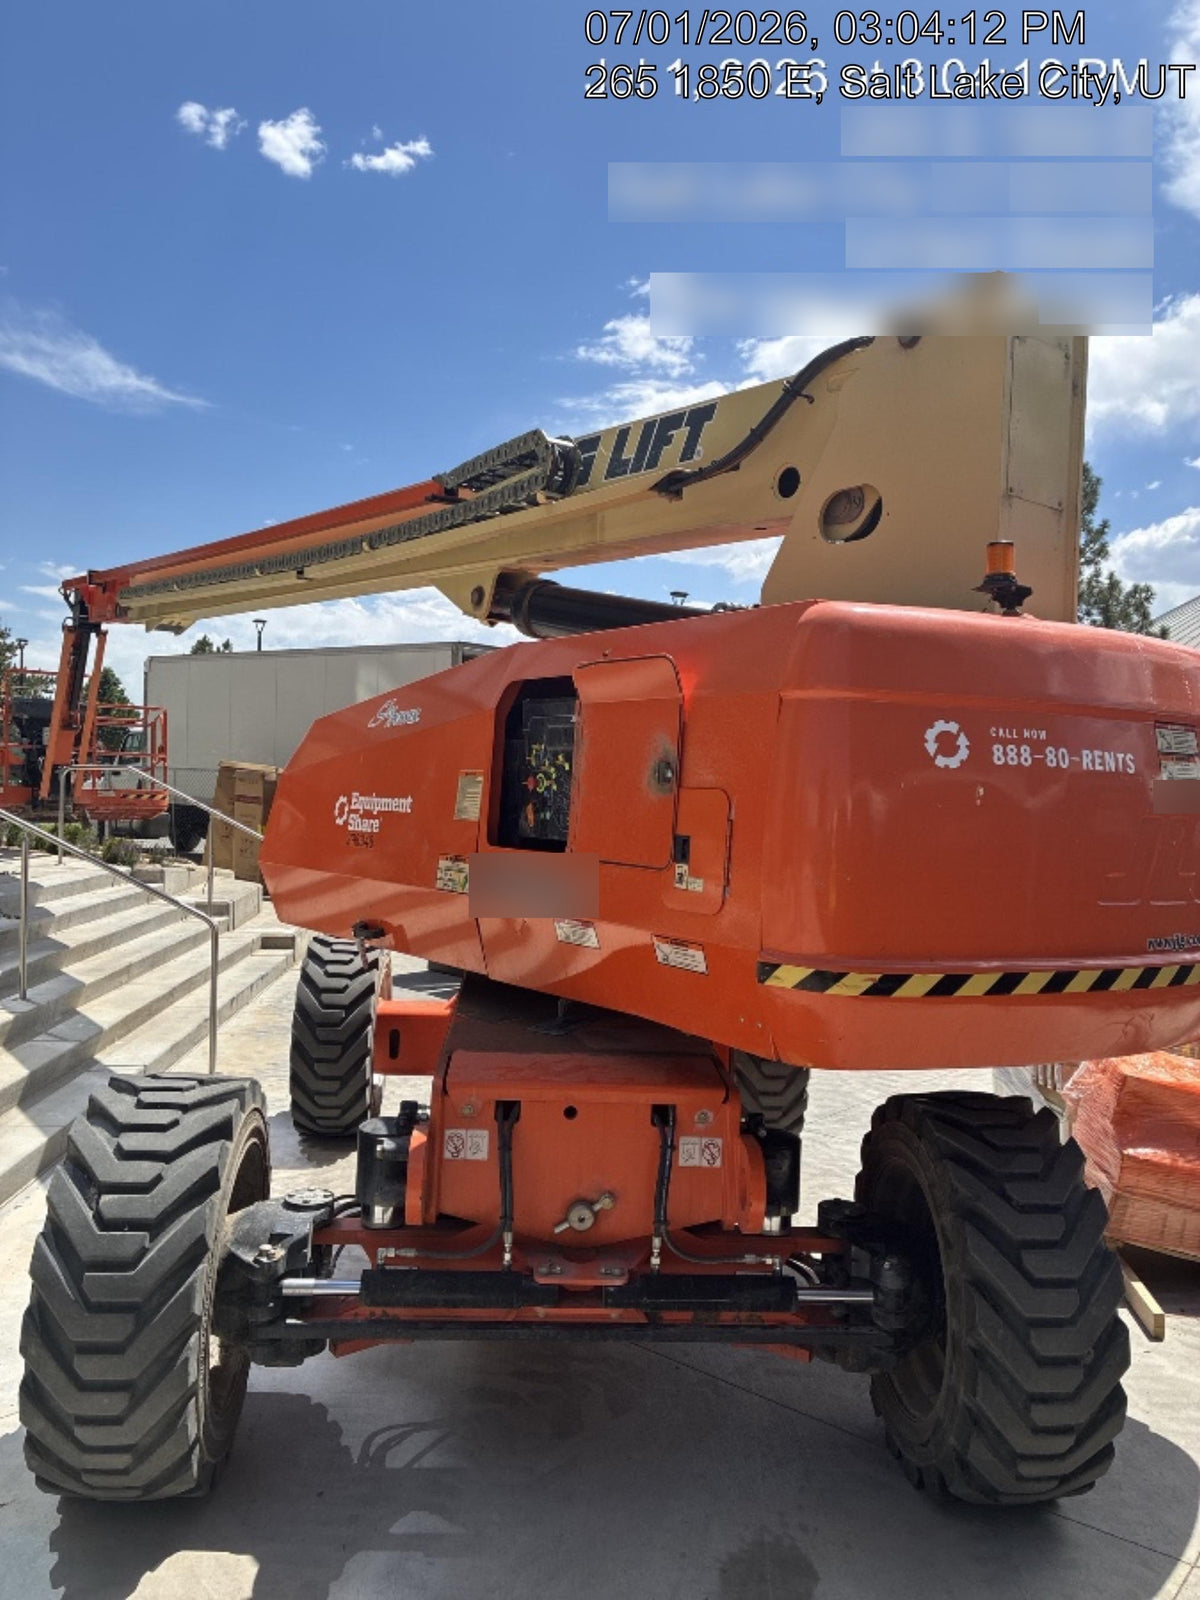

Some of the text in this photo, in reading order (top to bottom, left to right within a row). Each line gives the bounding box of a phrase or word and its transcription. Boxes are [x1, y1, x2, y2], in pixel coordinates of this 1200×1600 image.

[603, 401, 720, 482] LIFT
[989, 726, 1048, 742] CALL NOW
[991, 743, 1136, 775] 888-80-RENTS
[349, 791, 414, 815] Equipment
[347, 813, 381, 833] Share
